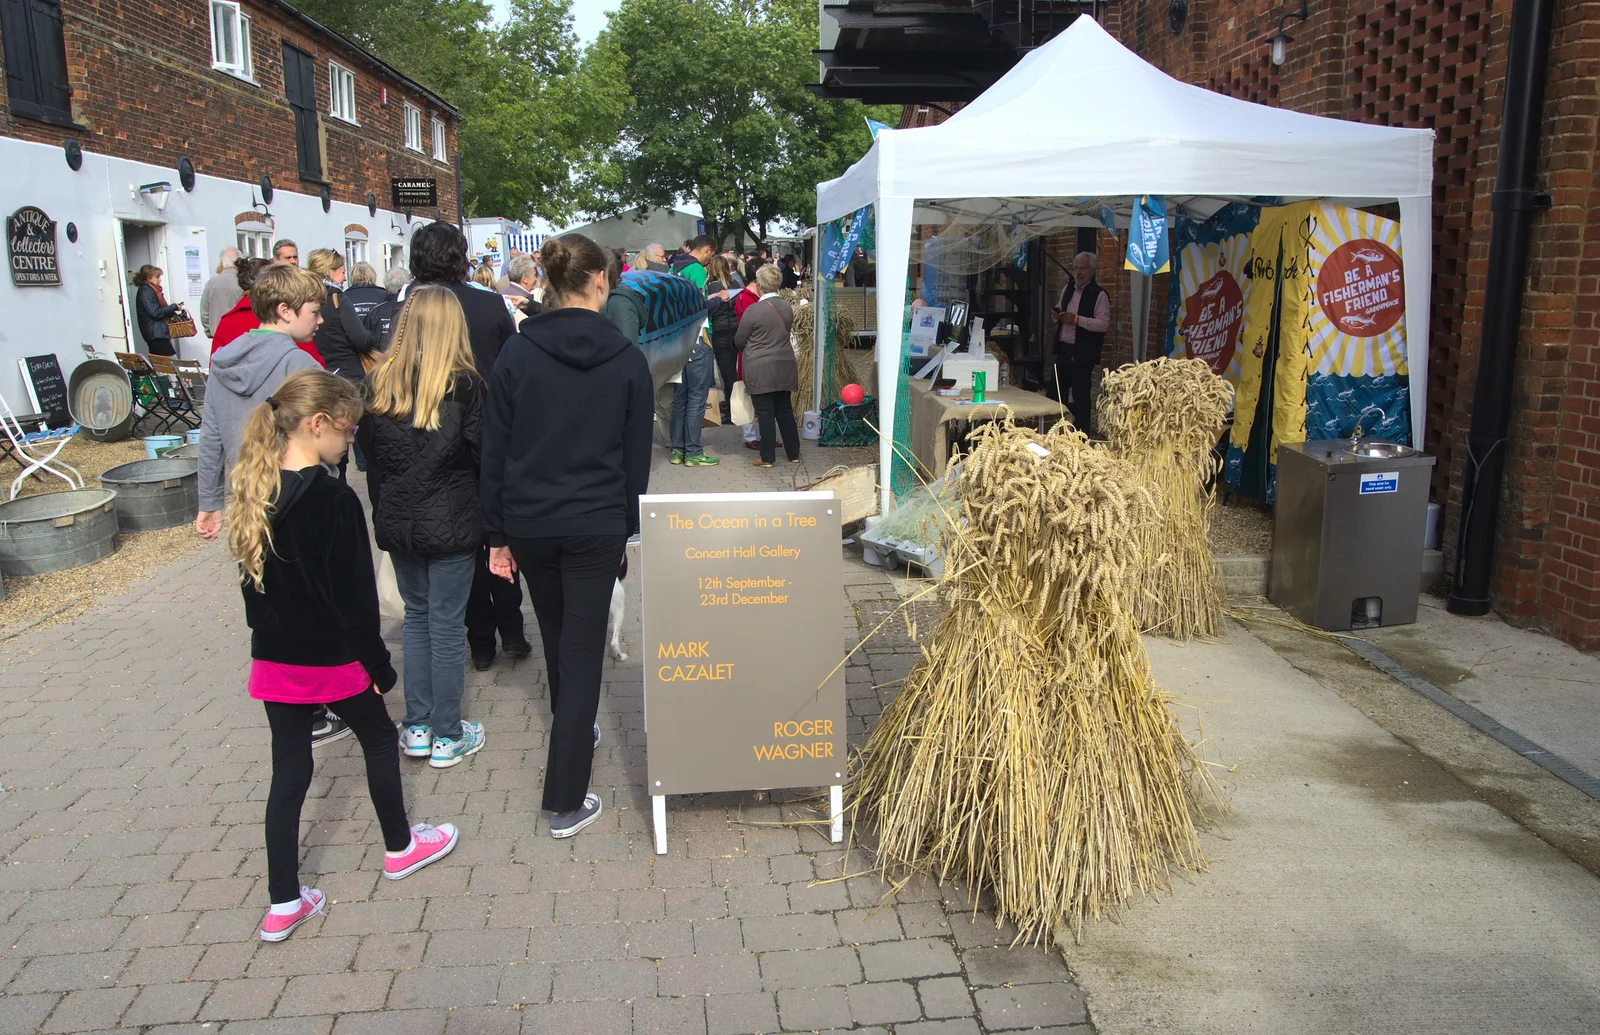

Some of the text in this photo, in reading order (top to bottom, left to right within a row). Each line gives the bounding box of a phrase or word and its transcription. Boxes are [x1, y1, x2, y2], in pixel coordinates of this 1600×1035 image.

[399, 197, 431, 205] Boutique
[13, 210, 50, 234] ANTIQUE
[27, 223, 35, 236] &
[11, 235, 55, 255] Collectors
[12, 255, 56, 270] CENTRE
[14, 273, 26, 281] OPEN
[44, 273, 58, 281] WEEK
[1344, 264, 1374, 284] BE A
[1323, 269, 1400, 305] FISHERMAN'S
[1198, 296, 1226, 322] BE A
[1345, 288, 1388, 313] FRIEND
[667, 512, 817, 530] The Ocean in a Tree
[685, 545, 801, 560] Concert Hall Gallery
[698, 576, 723, 589] 12th
[726, 575, 786, 591] September
[700, 591, 789, 606] 23rd December
[658, 641, 710, 659] MARK
[658, 663, 735, 682] CAZALET
[774, 719, 834, 738] ROGER
[753, 742, 834, 761] WAGNER
